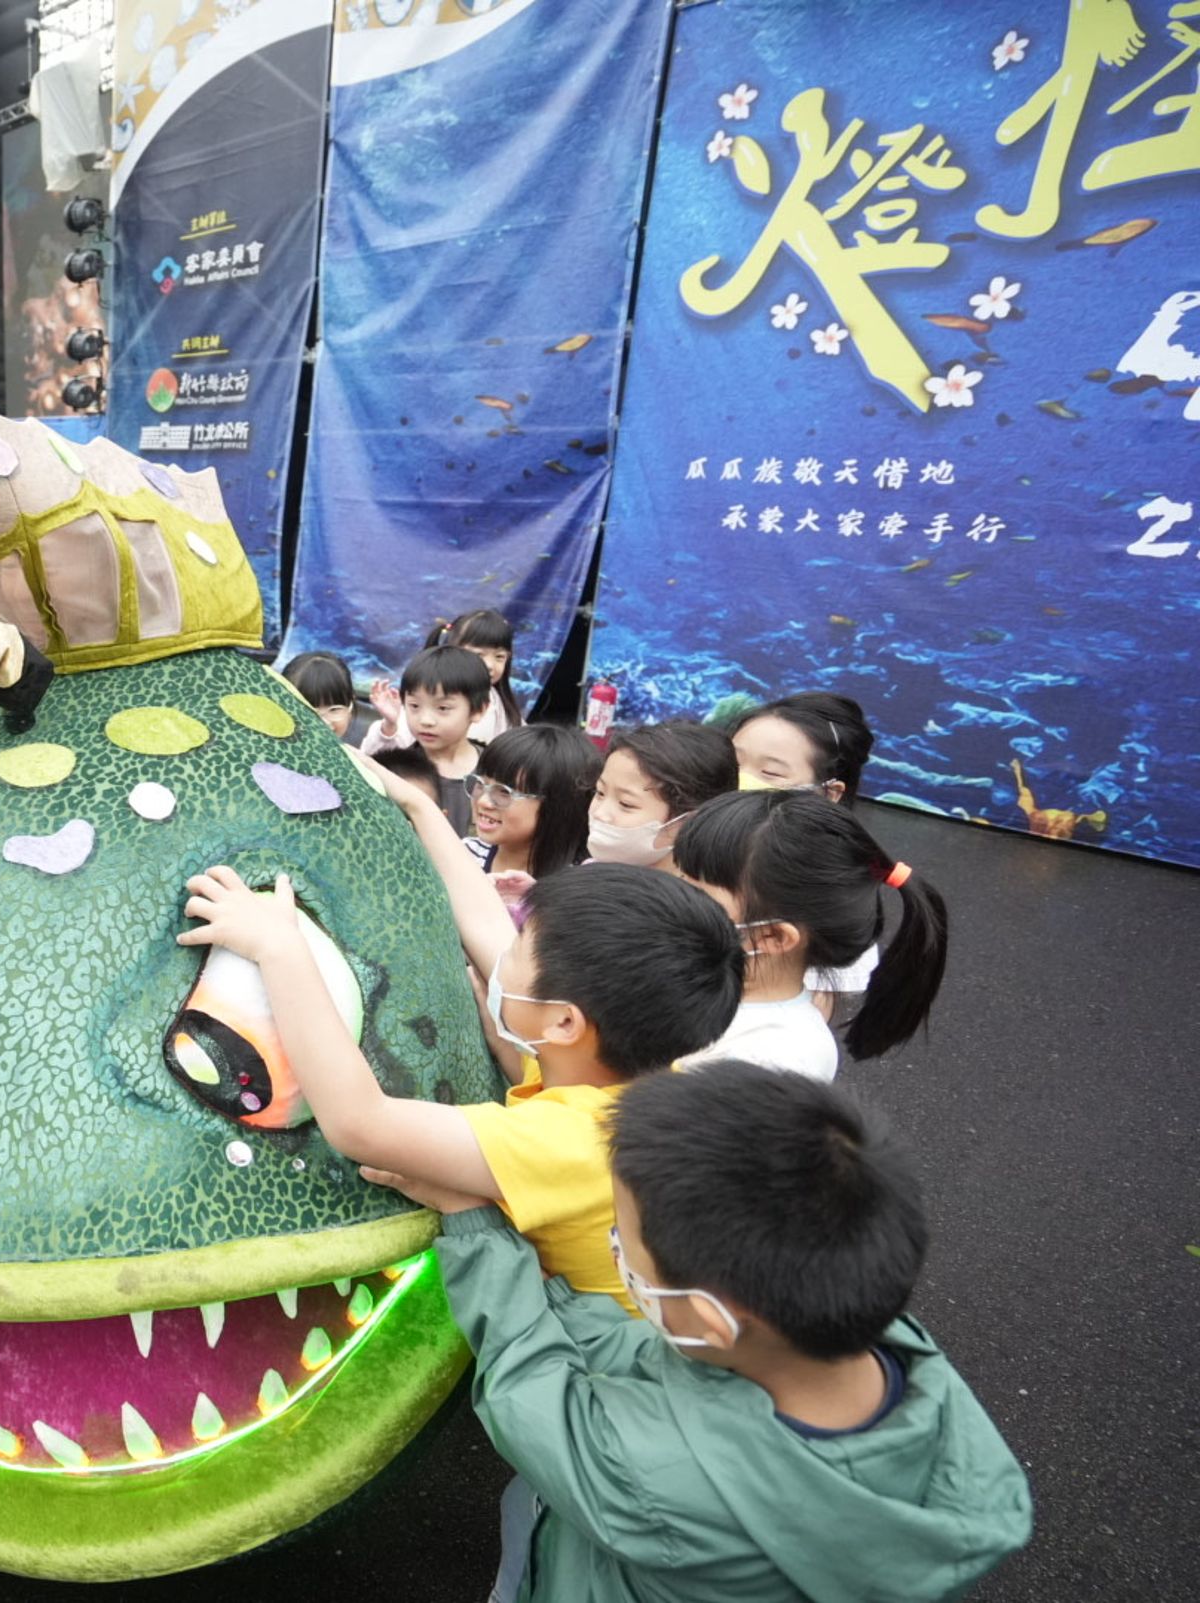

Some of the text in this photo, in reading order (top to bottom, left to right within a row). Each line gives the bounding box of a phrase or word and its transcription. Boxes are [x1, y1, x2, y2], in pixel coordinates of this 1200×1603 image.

[184, 241, 264, 273] 客家委員會
[231, 264, 260, 278] Council
[179, 368, 249, 396] 新竹縣政府
[721, 504, 1007, 543] 承蒙大家牽手行
